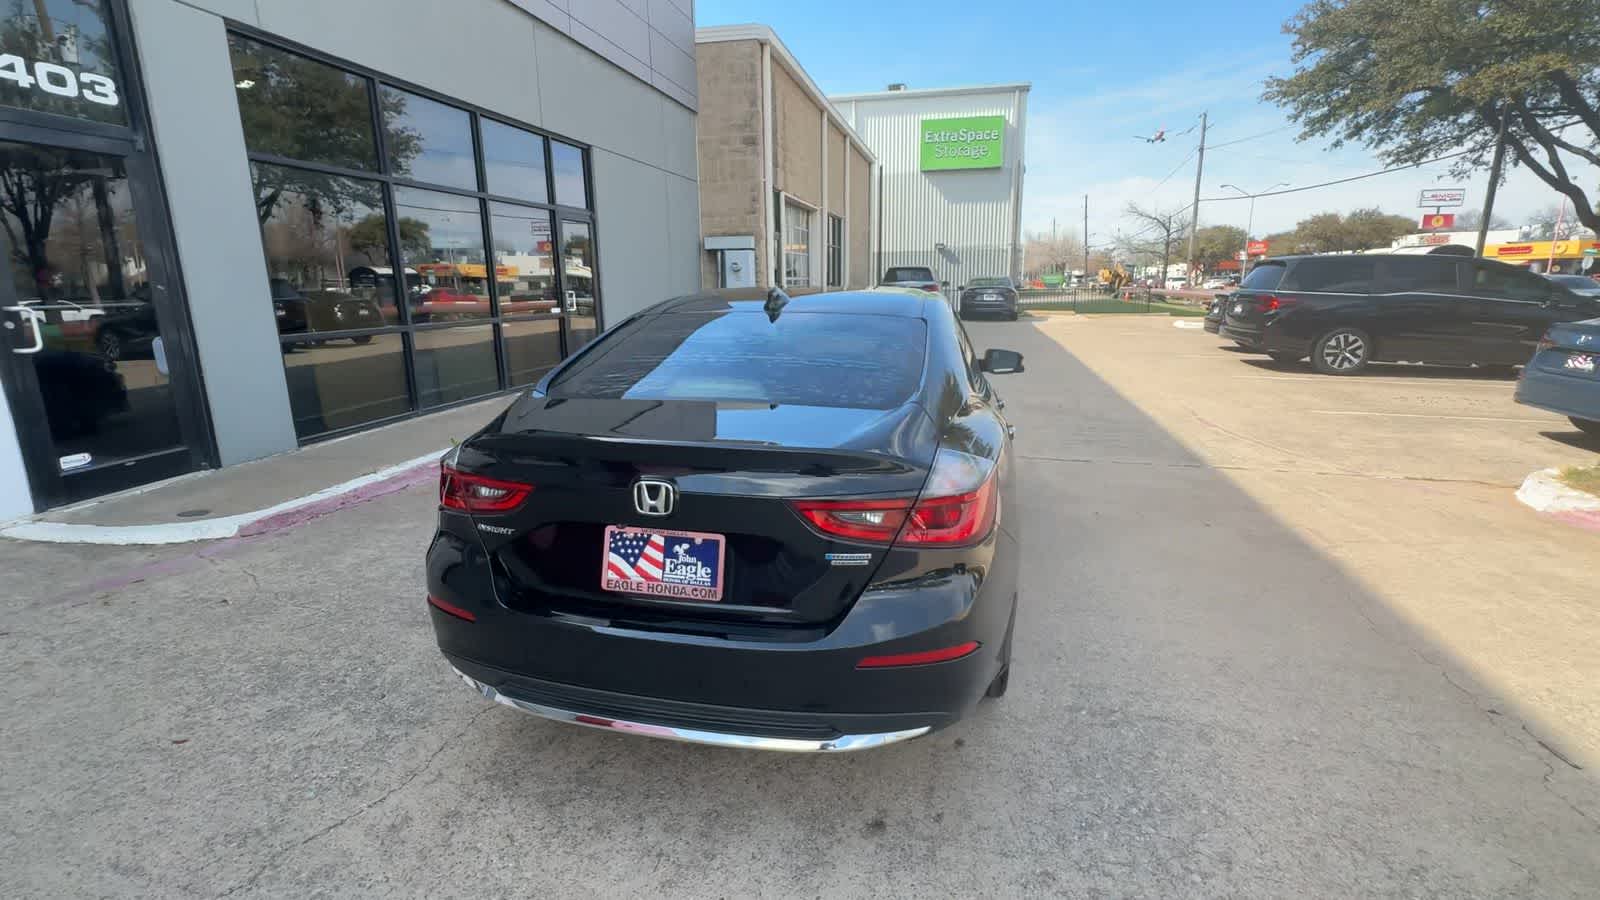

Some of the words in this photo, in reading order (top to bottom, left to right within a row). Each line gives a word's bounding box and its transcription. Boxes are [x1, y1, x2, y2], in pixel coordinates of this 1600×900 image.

[0, 53, 119, 106] 403
[935, 144, 988, 159] Storage
[477, 523, 516, 535] INSIGHT
[678, 554, 697, 564] John
[664, 558, 712, 580] Eagle
[606, 579, 643, 592] EAGLE
[647, 582, 718, 599] HONDA.COM
